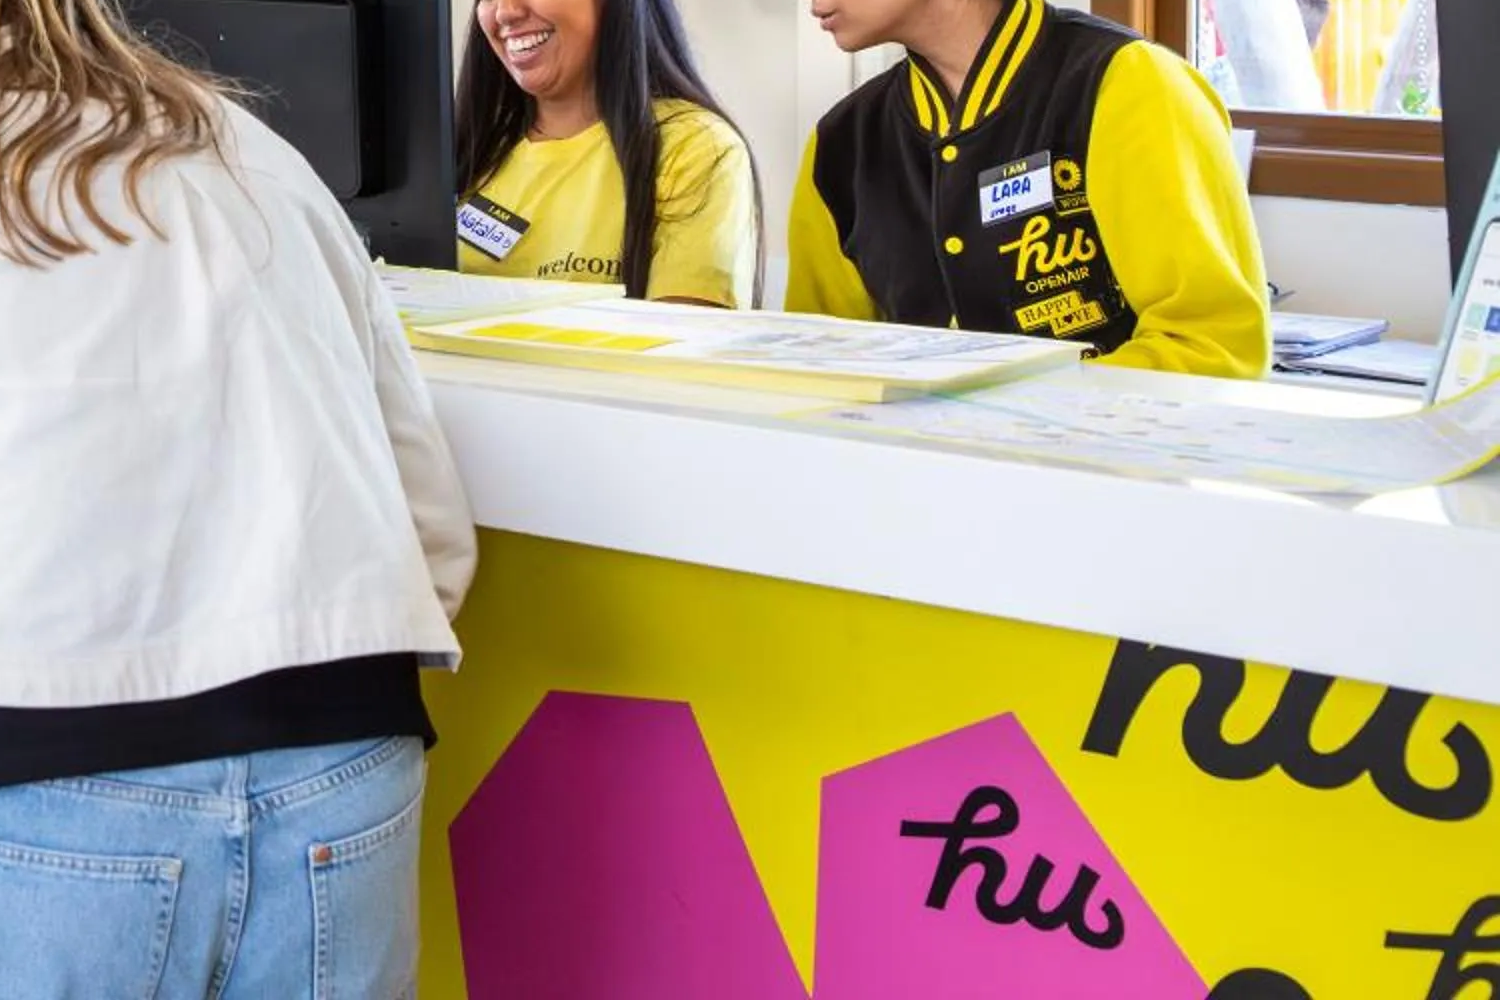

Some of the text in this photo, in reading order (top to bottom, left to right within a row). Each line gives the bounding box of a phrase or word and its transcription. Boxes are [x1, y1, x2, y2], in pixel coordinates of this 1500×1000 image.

[1008, 162, 1027, 176] AM
[992, 176, 1031, 203] LARA
[495, 208, 512, 221] AM
[999, 215, 1097, 281] hu
[1023, 296, 1073, 323] HAPPY
[900, 785, 1125, 950] hu
